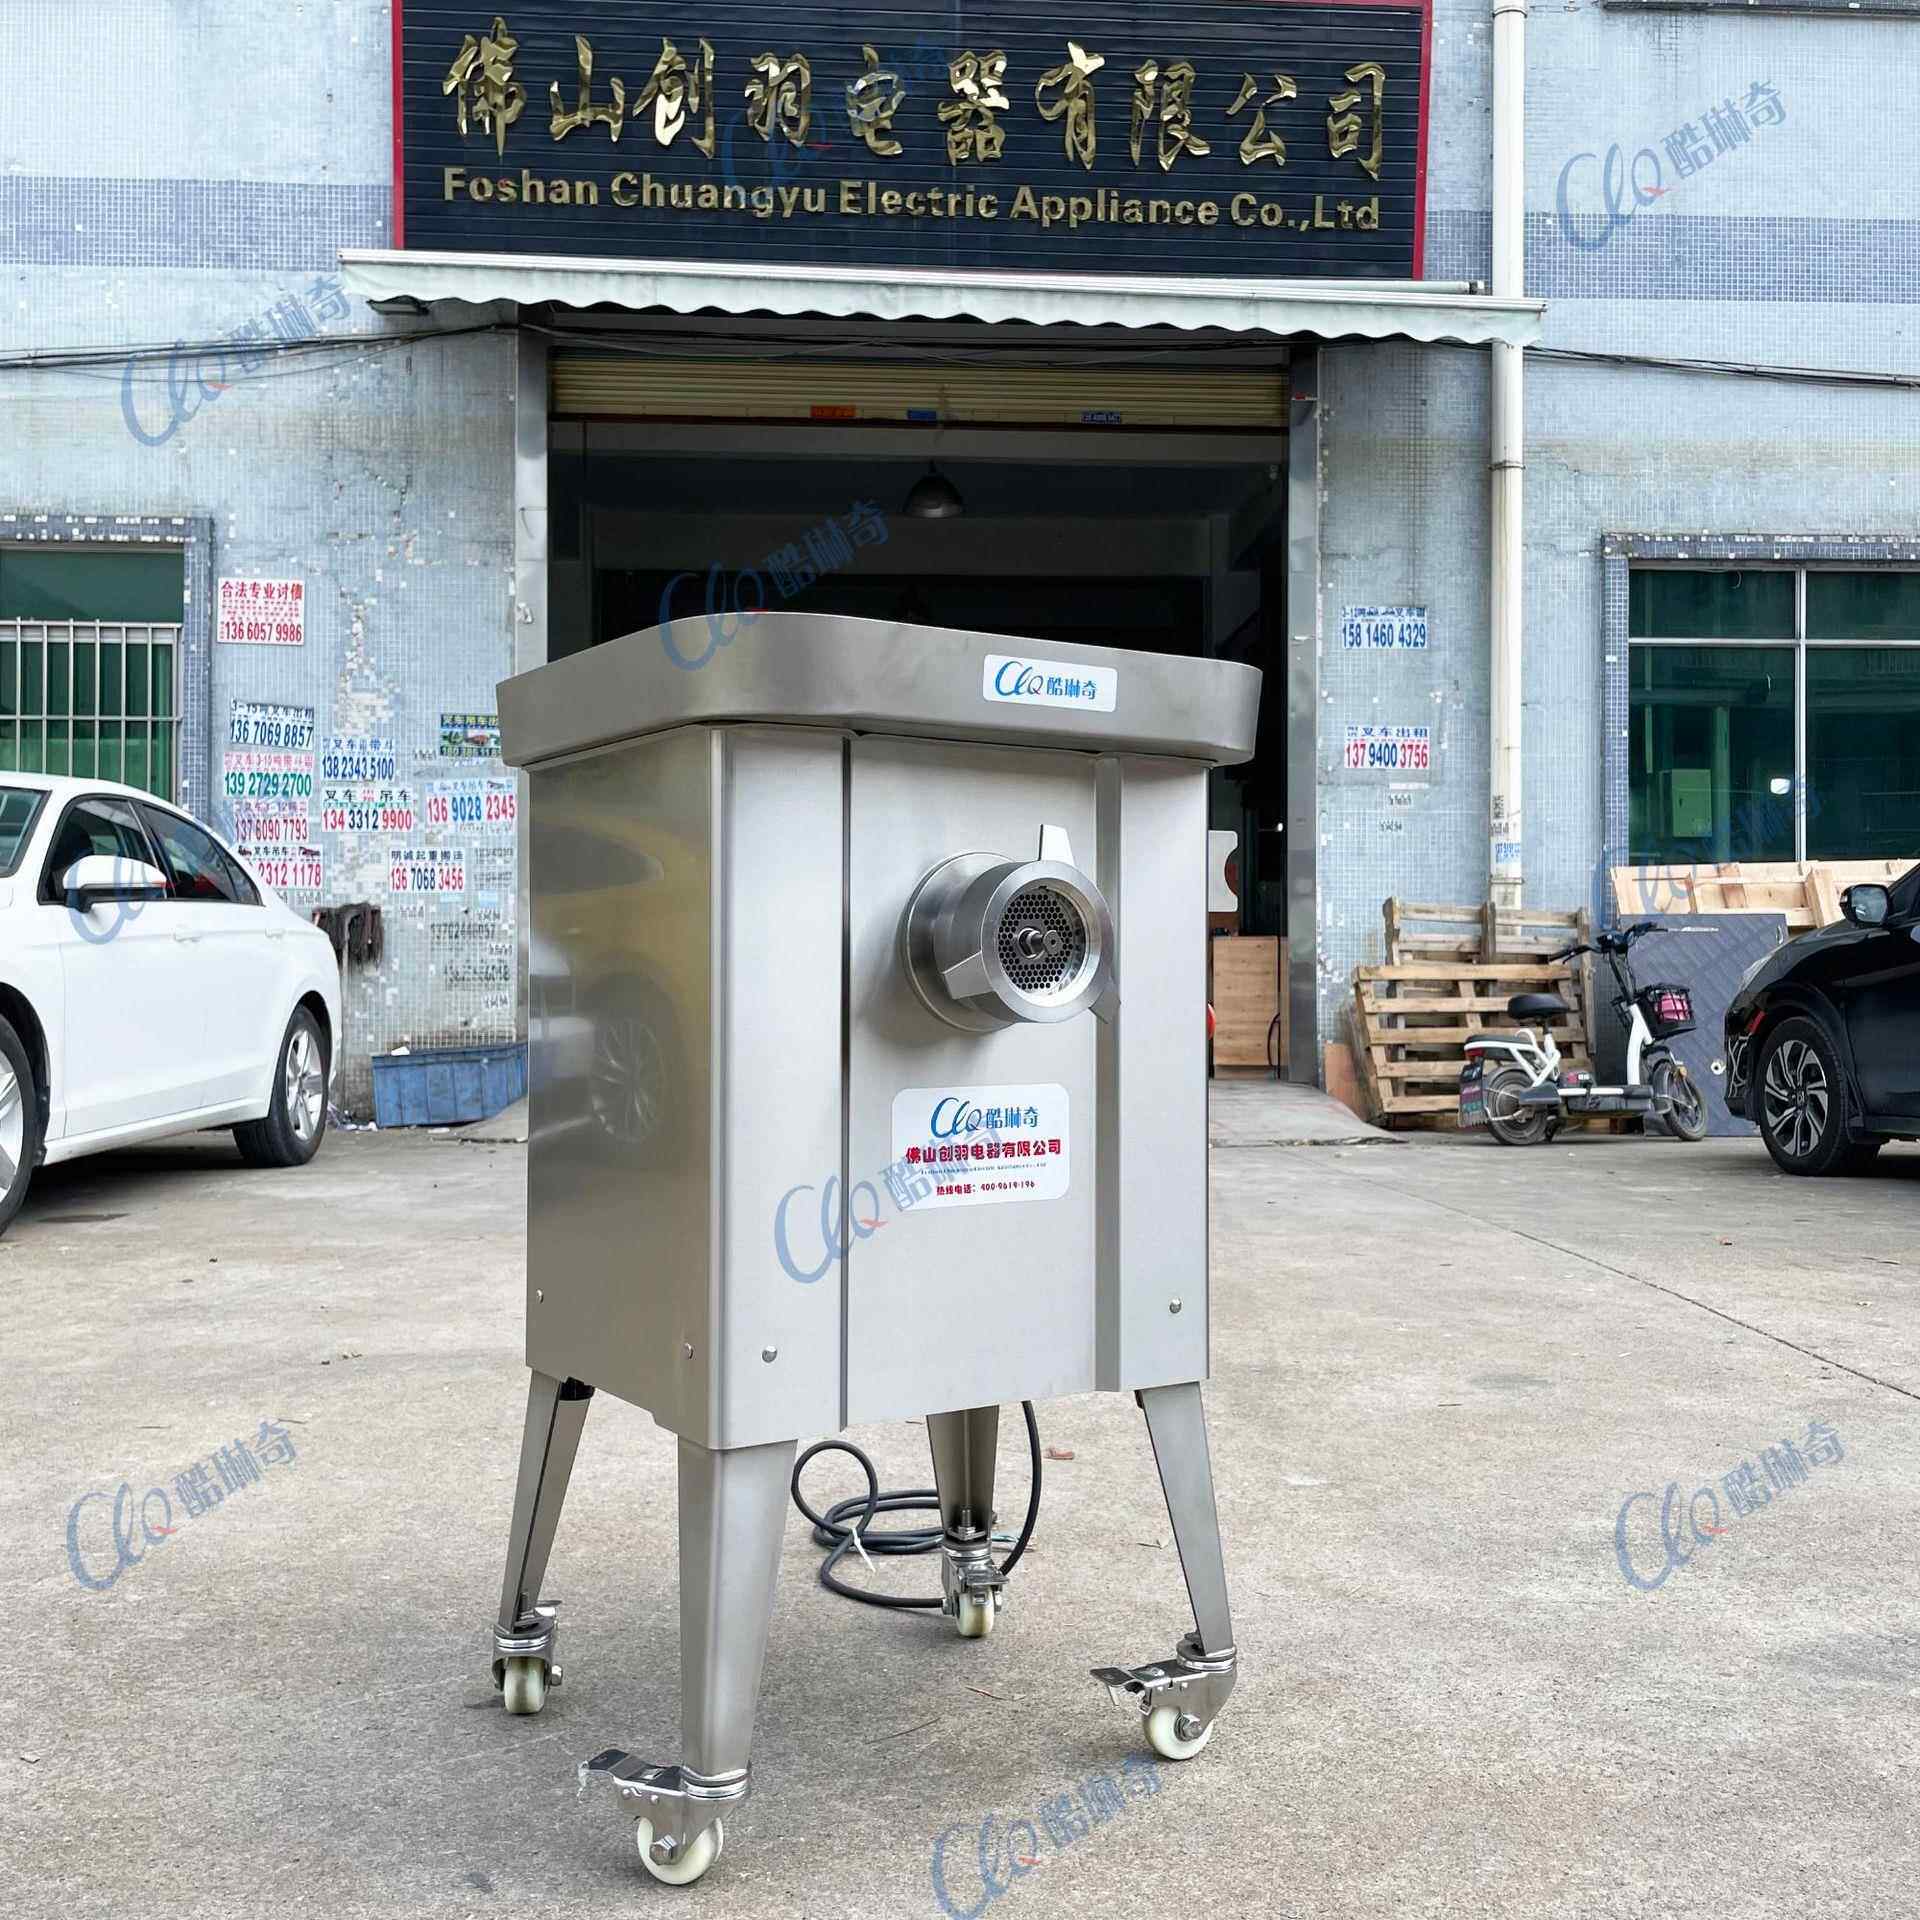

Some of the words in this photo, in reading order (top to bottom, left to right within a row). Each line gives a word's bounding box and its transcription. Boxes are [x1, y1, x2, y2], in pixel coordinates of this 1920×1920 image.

[444, 167, 598, 207] Foshan
[610, 171, 826, 218] Chuangyu
[839, 181, 998, 220] Electric
[1010, 185, 1219, 230] Appliance
[1230, 193, 1380, 231] Co.,Ltd
[225, 621, 245, 640] 136
[247, 621, 272, 641] 6057
[276, 623, 302, 642] 9986
[1343, 623, 1361, 648] 158
[1367, 623, 1394, 648] 1460
[1398, 623, 1426, 648] 4329
[1046, 677, 1097, 700] 酷琳奇
[230, 719, 249, 743] 136
[253, 721, 281, 746] 7069
[284, 724, 313, 748] 8857
[322, 755, 339, 778] 138
[341, 756, 367, 779] 2343
[370, 757, 394, 780] 5100
[1346, 743, 1366, 767] 137
[1369, 743, 1397, 767] 9400
[1400, 743, 1428, 768] 3756
[225, 772, 245, 795] 139
[248, 772, 280, 797] 2729
[282, 773, 312, 798] 2700
[324, 809, 345, 830] 134
[348, 809, 379, 829] 3312
[382, 809, 412, 830] 9900
[428, 798, 448, 822] 136
[451, 796, 482, 821] 9028
[486, 795, 515, 820] 2345
[236, 817, 252, 841] 137
[255, 819, 280, 841] 6090
[283, 819, 307, 840] 7793
[293, 863, 320, 887] 1178
[391, 868, 407, 890] 136
[411, 867, 436, 890] 7068
[438, 868, 463, 890] 3456
[985, 1106, 1038, 1129] 酷琳奇
[905, 1139, 1062, 1164] 佛山创羽电器有限公司
